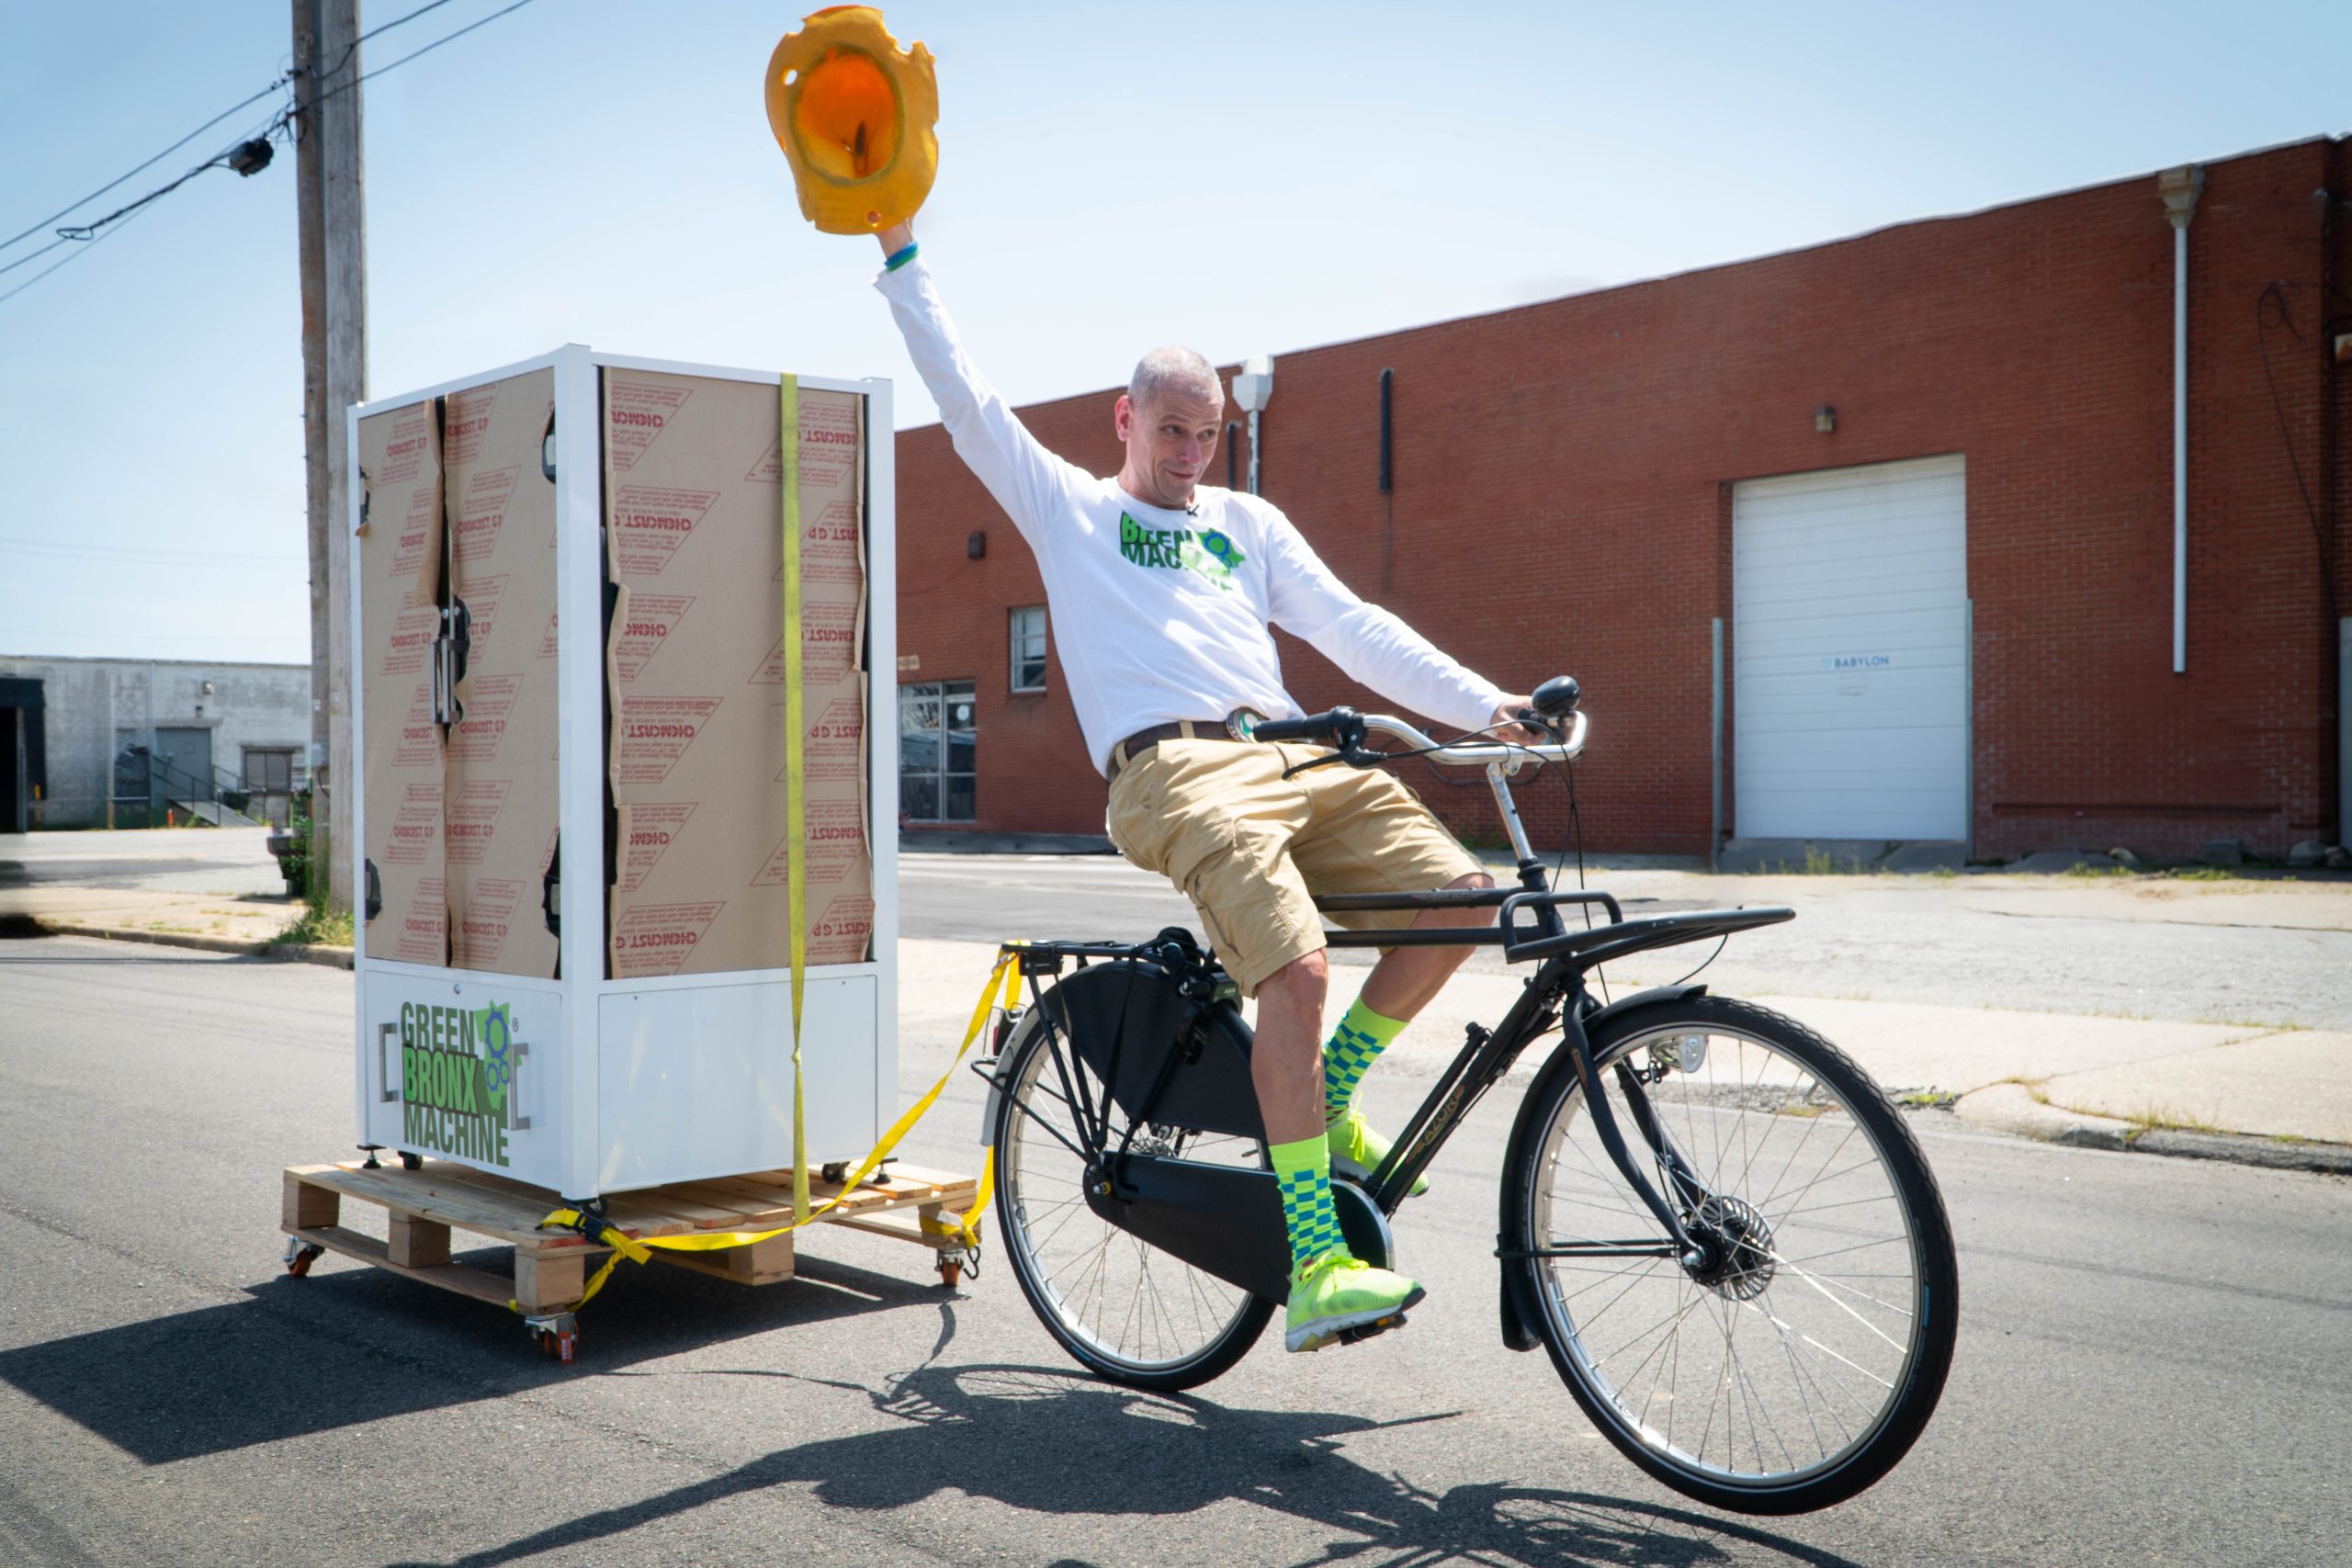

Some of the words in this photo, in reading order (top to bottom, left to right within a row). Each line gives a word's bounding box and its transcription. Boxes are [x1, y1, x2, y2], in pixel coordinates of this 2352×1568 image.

[1834, 654, 1889, 669] BABYLON
[401, 1001, 476, 1055] GREEN
[402, 1043, 480, 1118] BRONX
[403, 1105, 510, 1168] MACHINE
